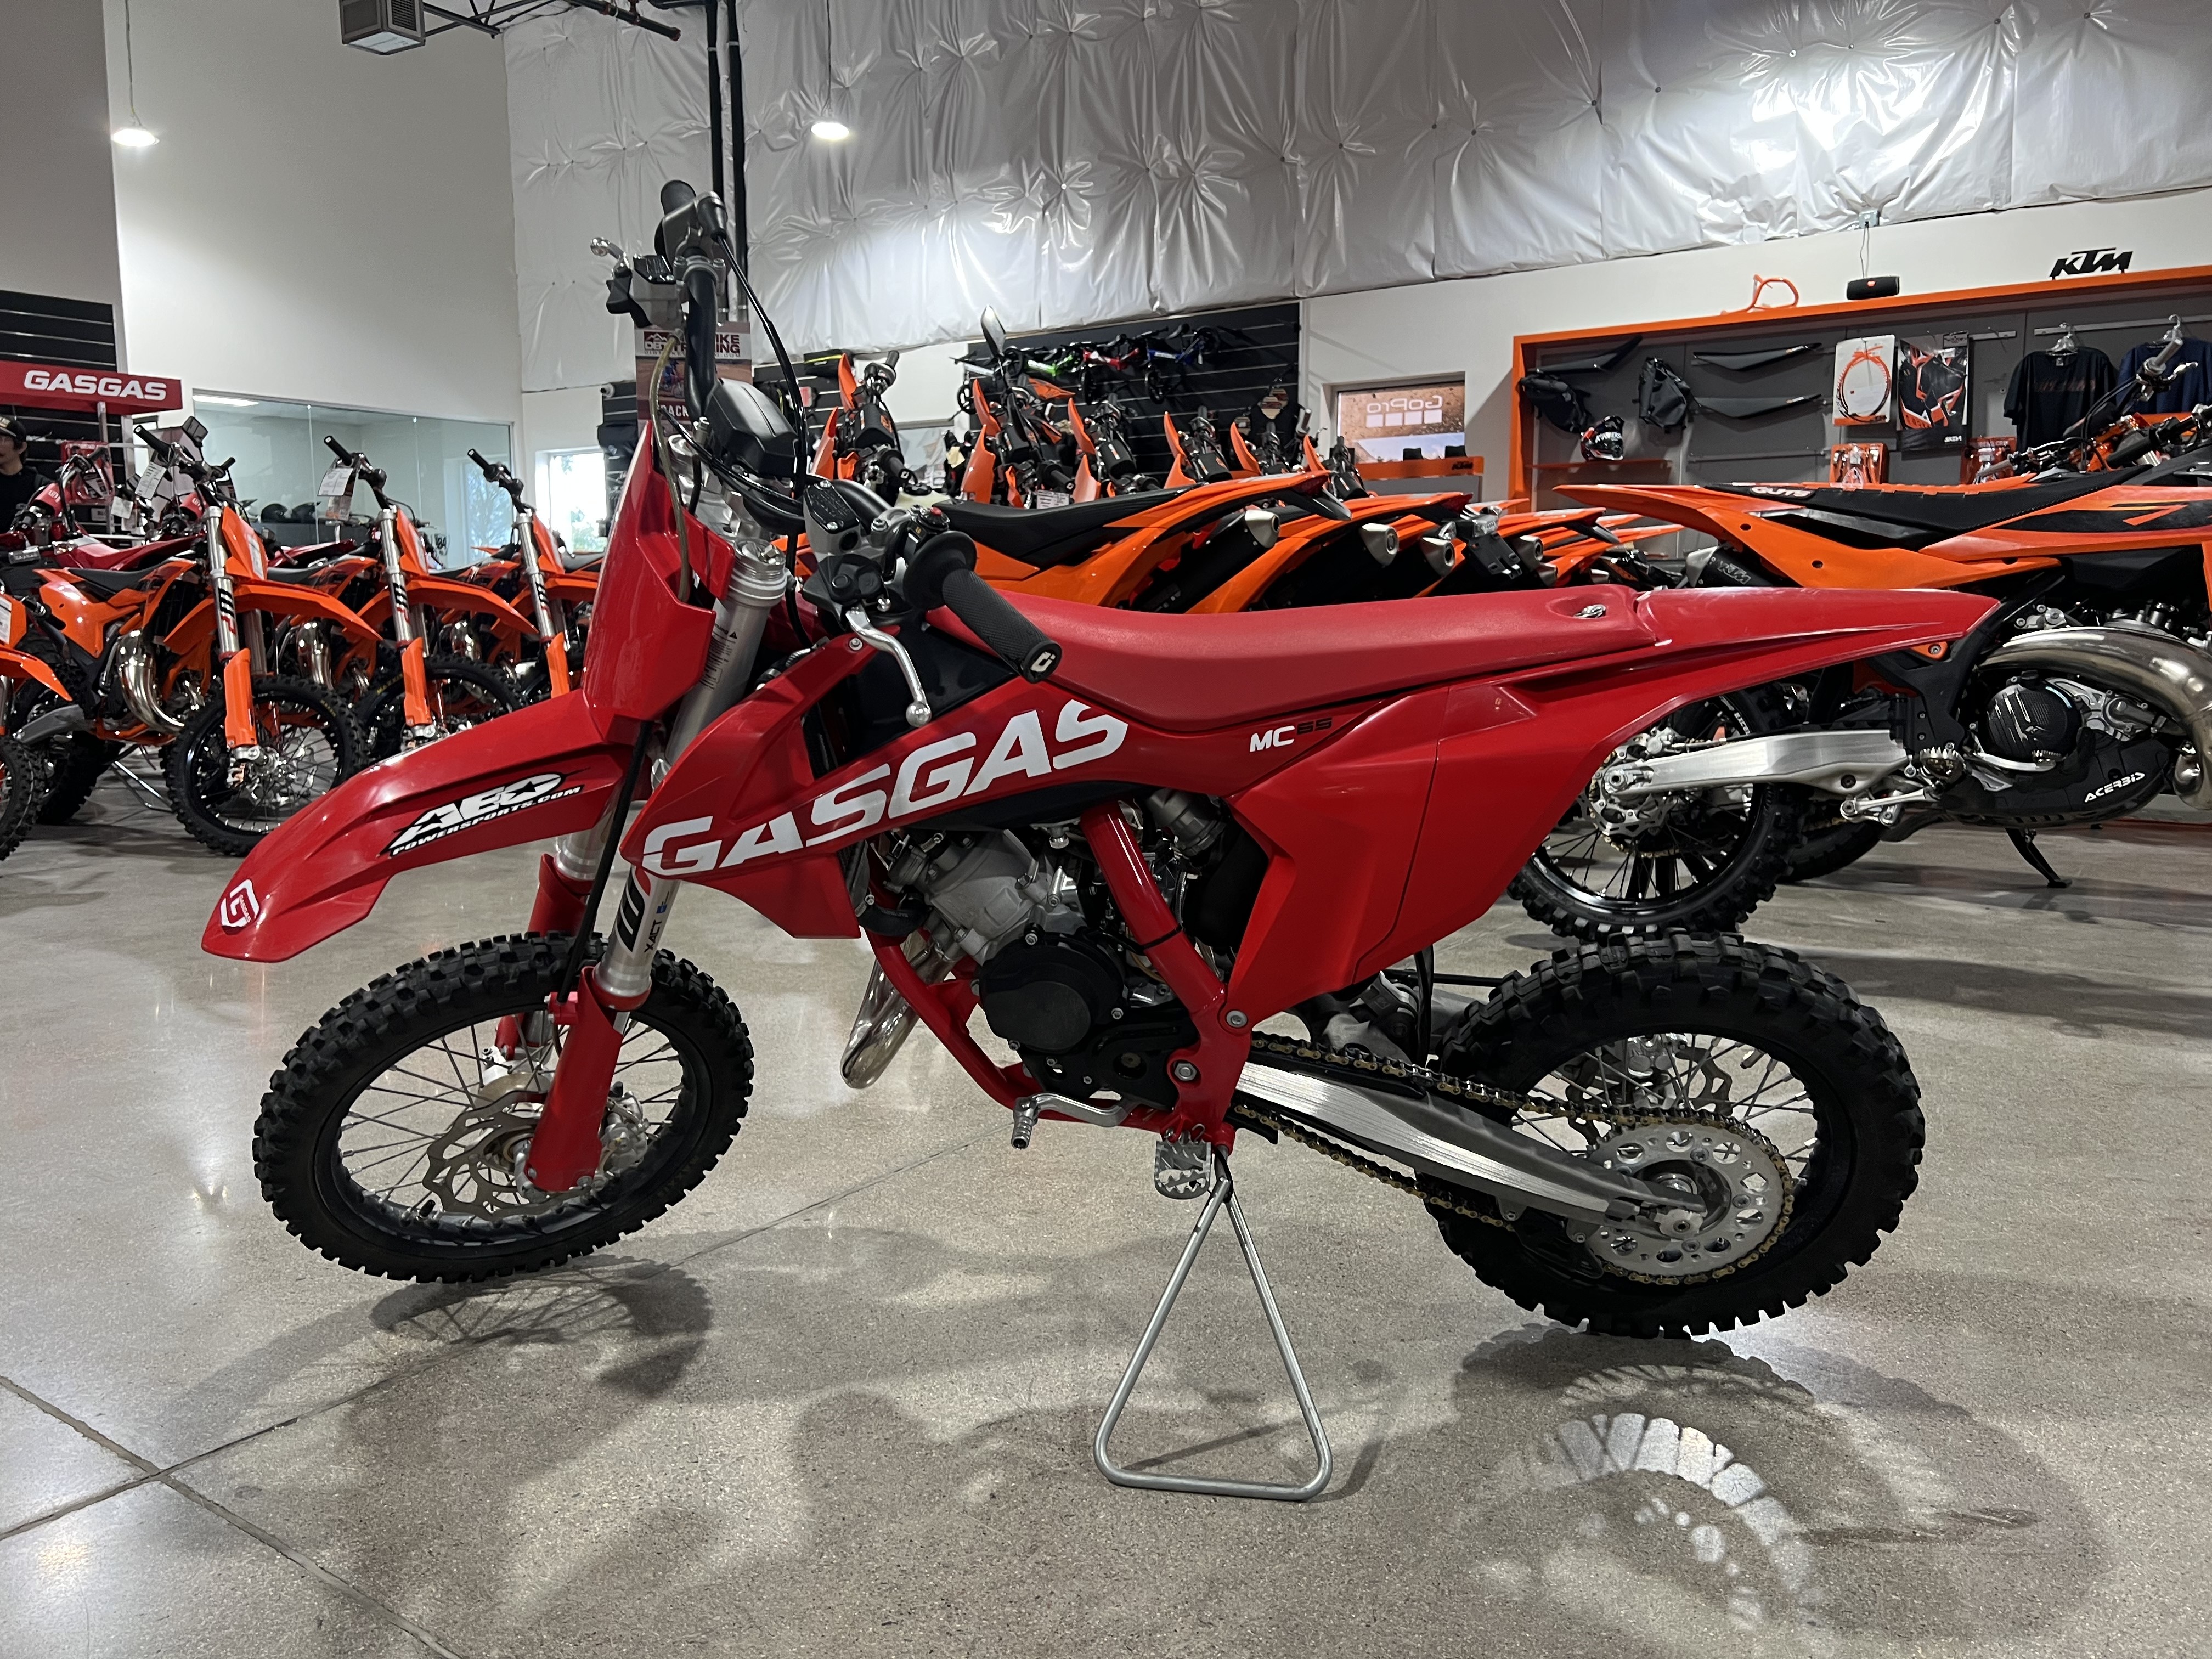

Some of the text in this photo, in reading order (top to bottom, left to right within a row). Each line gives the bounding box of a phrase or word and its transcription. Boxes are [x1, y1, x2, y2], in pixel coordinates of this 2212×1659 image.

[2049, 247, 2133, 278] KTM
[24, 370, 167, 400] GASGAS
[1717, 560, 1751, 585] KTM
[1249, 725, 1295, 753] MC
[642, 699, 1128, 876] GASGAS
[2085, 772, 2145, 803] ACERBIS
[388, 774, 562, 849] AEO
[392, 786, 581, 856] POWERSPORTS.COM
[644, 919, 662, 953] XACT
